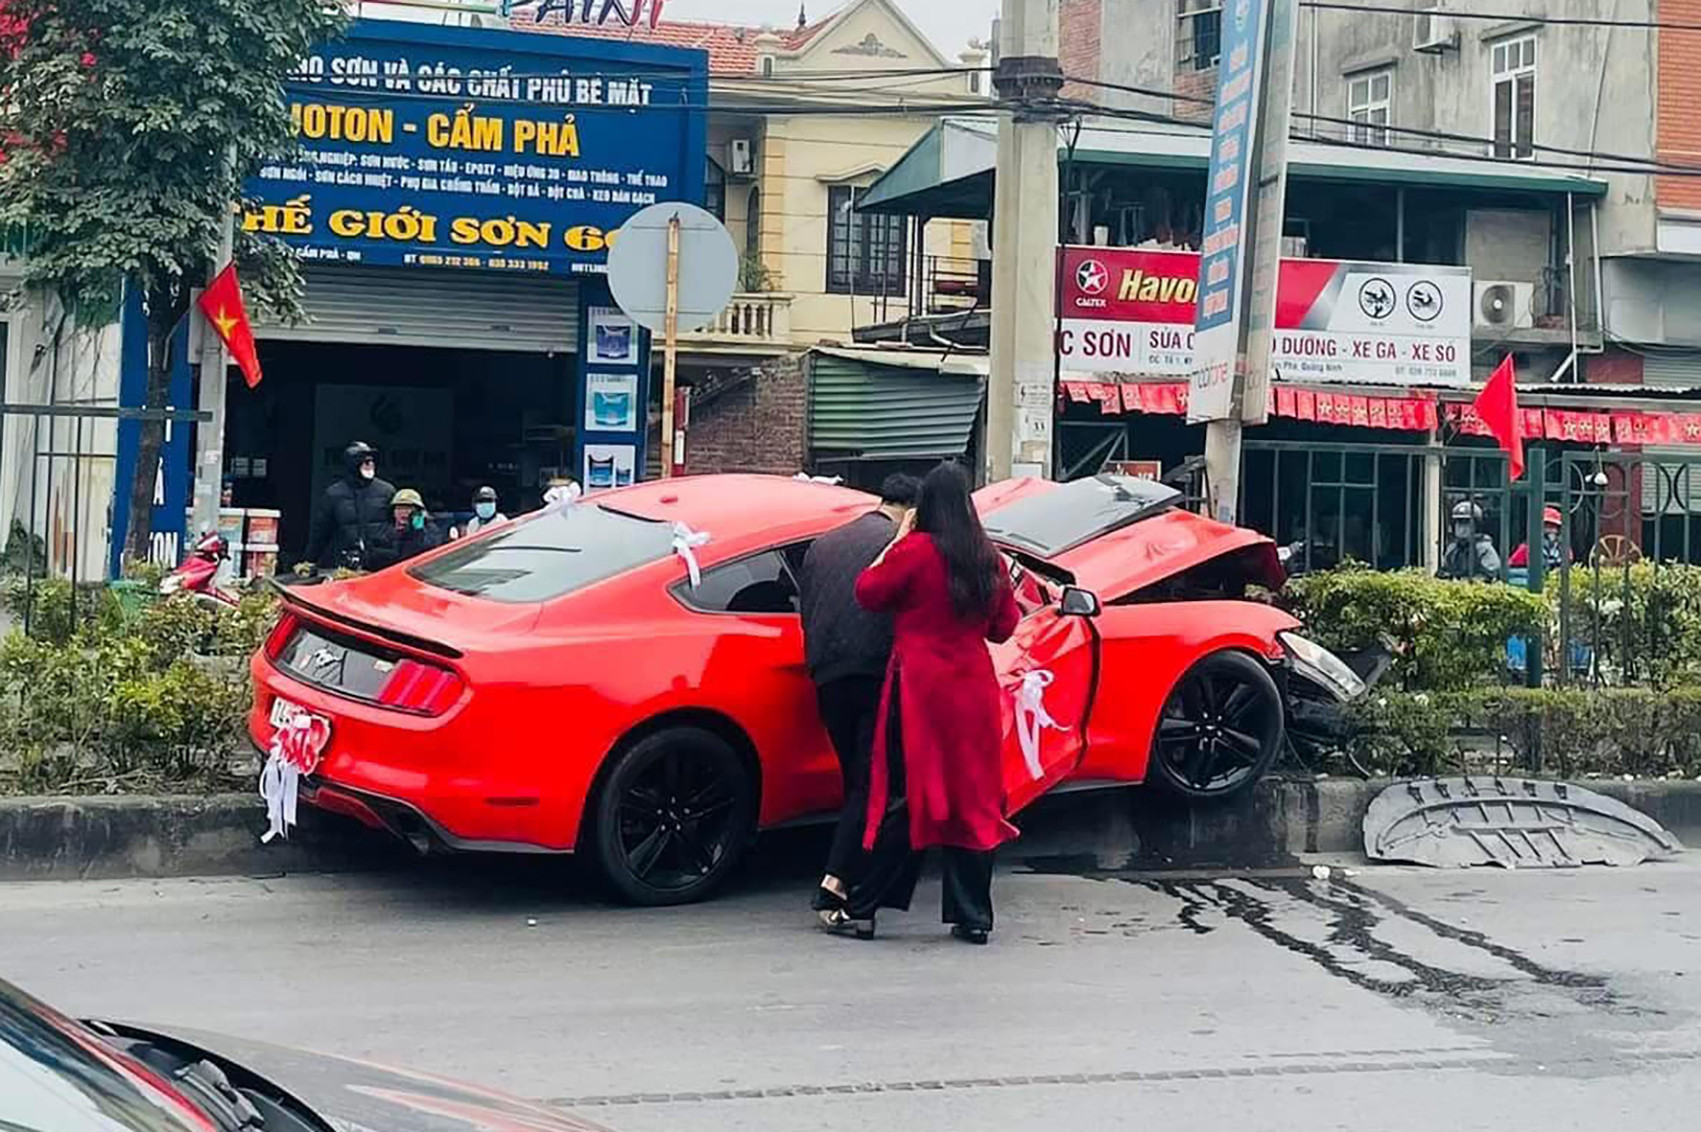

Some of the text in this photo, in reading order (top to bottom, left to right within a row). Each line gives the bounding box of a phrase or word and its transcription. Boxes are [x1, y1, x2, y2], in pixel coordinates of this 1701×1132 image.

[330, 56, 378, 87] SƠN
[384, 58, 411, 90] VÀ
[418, 61, 461, 95] CÁC
[467, 65, 520, 99] CHẤT
[527, 69, 572, 103] PHỦ
[608, 78, 653, 113] MẶT
[403, 122, 417, 132] -
[427, 102, 504, 151] CẨM
[514, 113, 580, 157] PHẢ
[465, 162, 496, 175] EPOXY
[241, 194, 313, 234] HẾ
[329, 206, 437, 243] GIỚI
[451, 216, 551, 249] SƠN
[1075, 297, 1106, 307] CALTEX
[1083, 328, 1131, 358] SƠN
[1149, 326, 1182, 350] SỬA
[1352, 341, 1371, 358] XE
[1376, 342, 1397, 359] GA
[1412, 343, 1430, 361] XE
